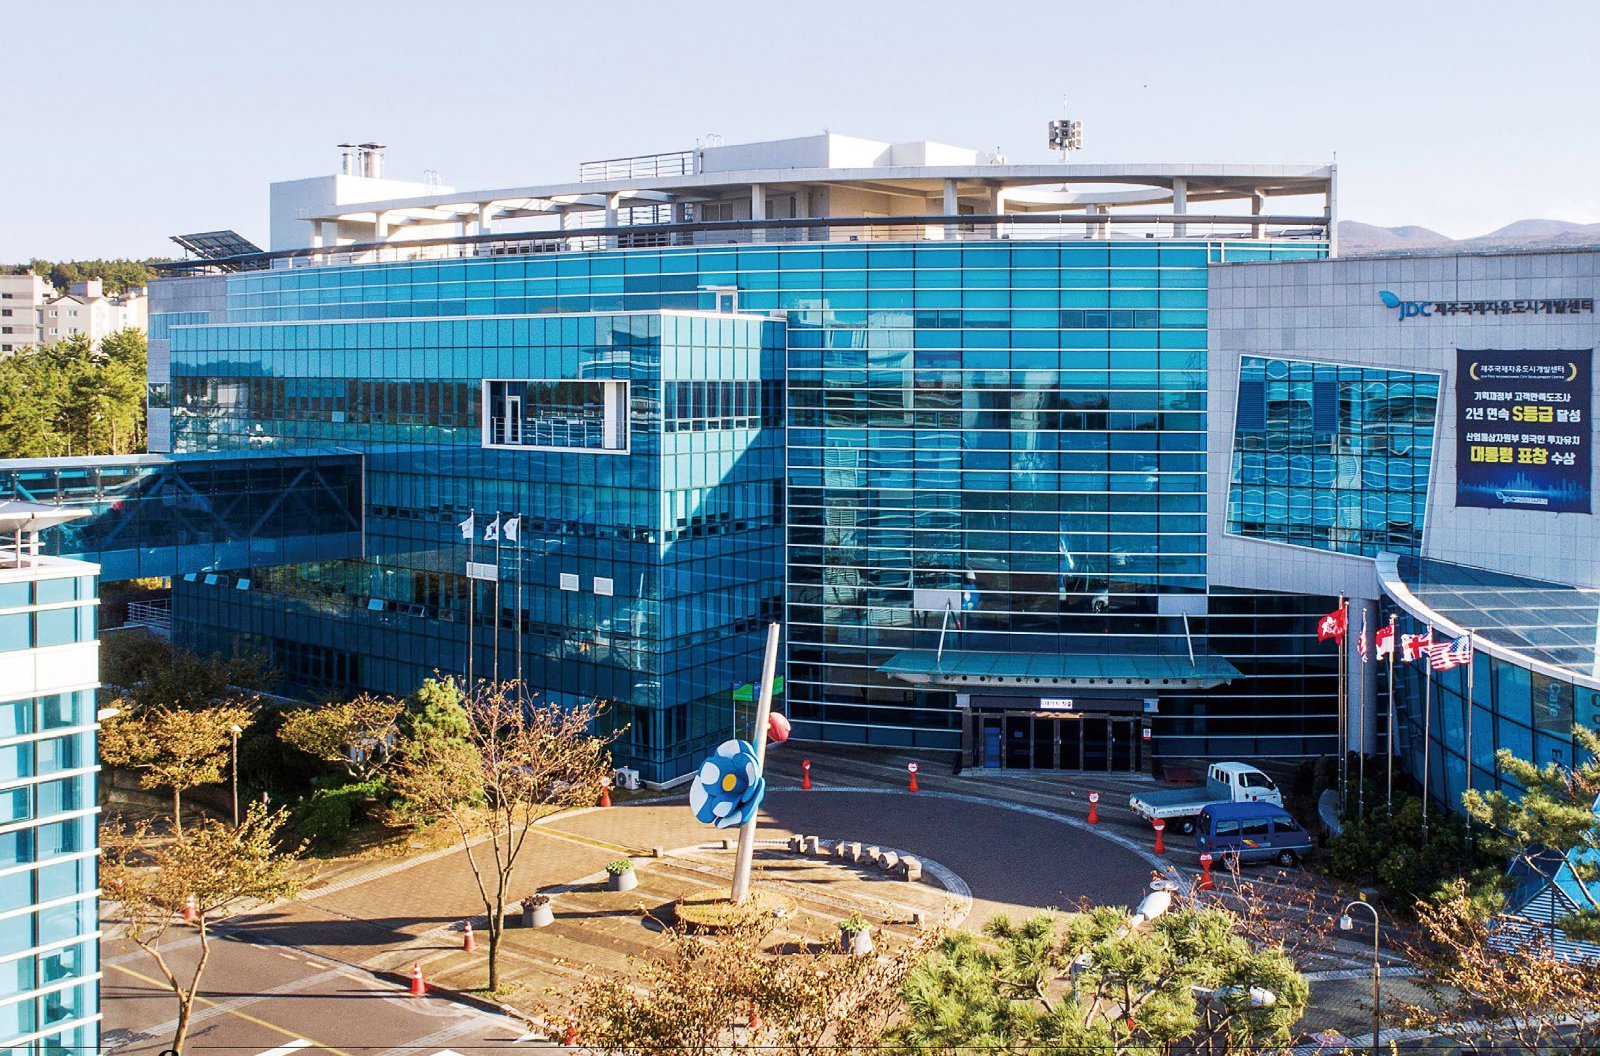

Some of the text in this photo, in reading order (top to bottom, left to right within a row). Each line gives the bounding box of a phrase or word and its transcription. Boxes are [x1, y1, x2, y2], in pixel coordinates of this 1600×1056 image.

[1399, 299, 1594, 321] JDC 제주국제자유도시개발센터
[1480, 365, 1565, 374] 제주국제자유도시개발센터
[1465, 405, 1581, 423] 2년 연속 S등급 달성
[1521, 434, 1546, 444] 외국인
[1547, 435, 1580, 445] 투자유치
[1470, 446, 1576, 465] 대통령 표창 수상
